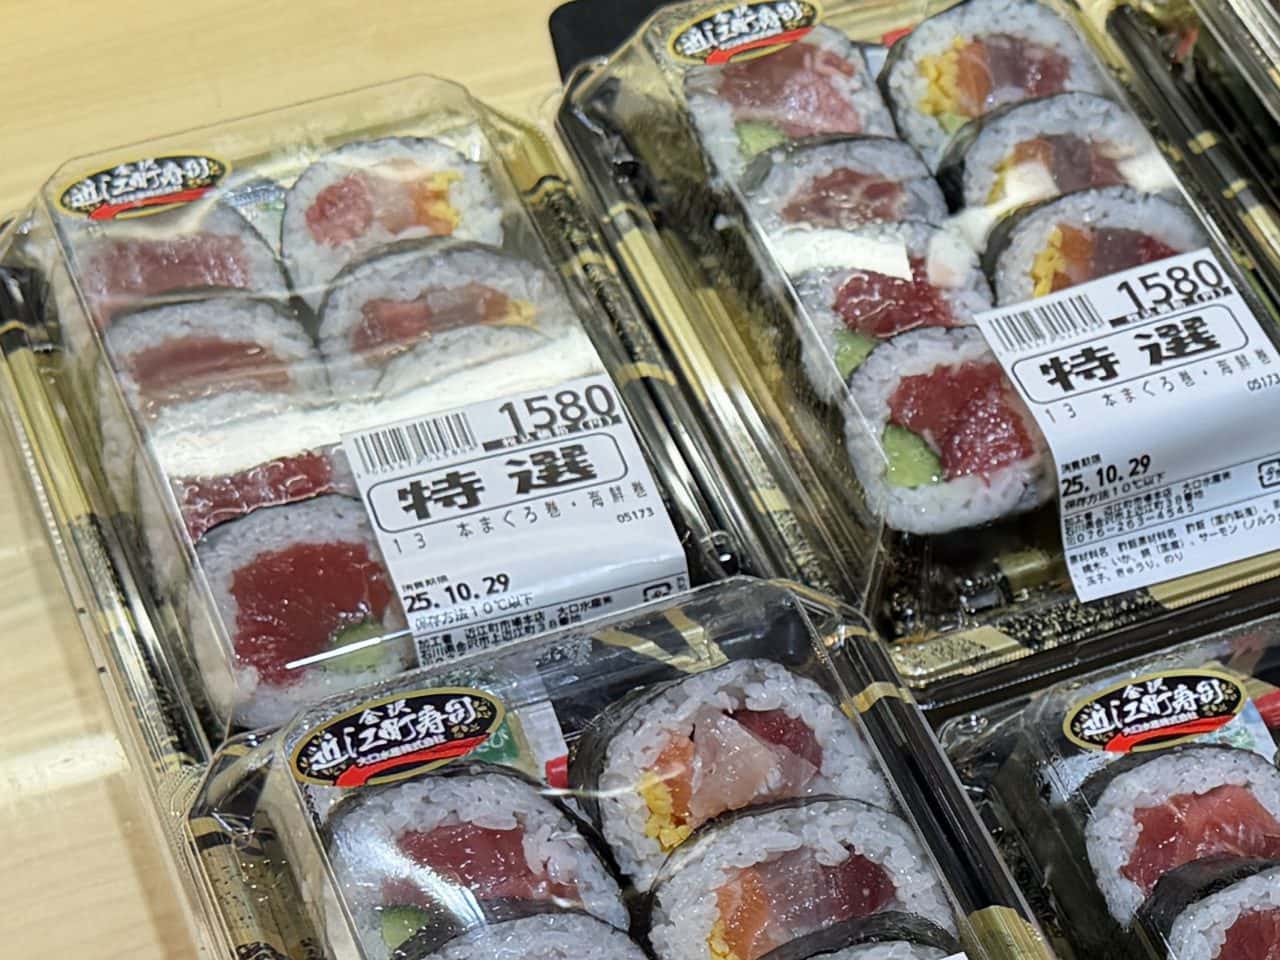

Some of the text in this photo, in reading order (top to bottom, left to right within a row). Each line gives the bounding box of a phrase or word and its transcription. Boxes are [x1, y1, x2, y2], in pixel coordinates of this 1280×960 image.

[1117, 260, 1223, 313] 1580
[1040, 316, 1221, 392] 特選
[498, 384, 615, 439] 1580
[1045, 403, 1077, 424] 13
[397, 444, 597, 520] 特選
[617, 507, 655, 523] 05173
[393, 533, 426, 553] 13
[359, 700, 411, 725] 金沢
[1082, 679, 1224, 736] 近江町寿司
[1123, 678, 1168, 699] 金沢
[310, 696, 477, 771] 近江町寿司
